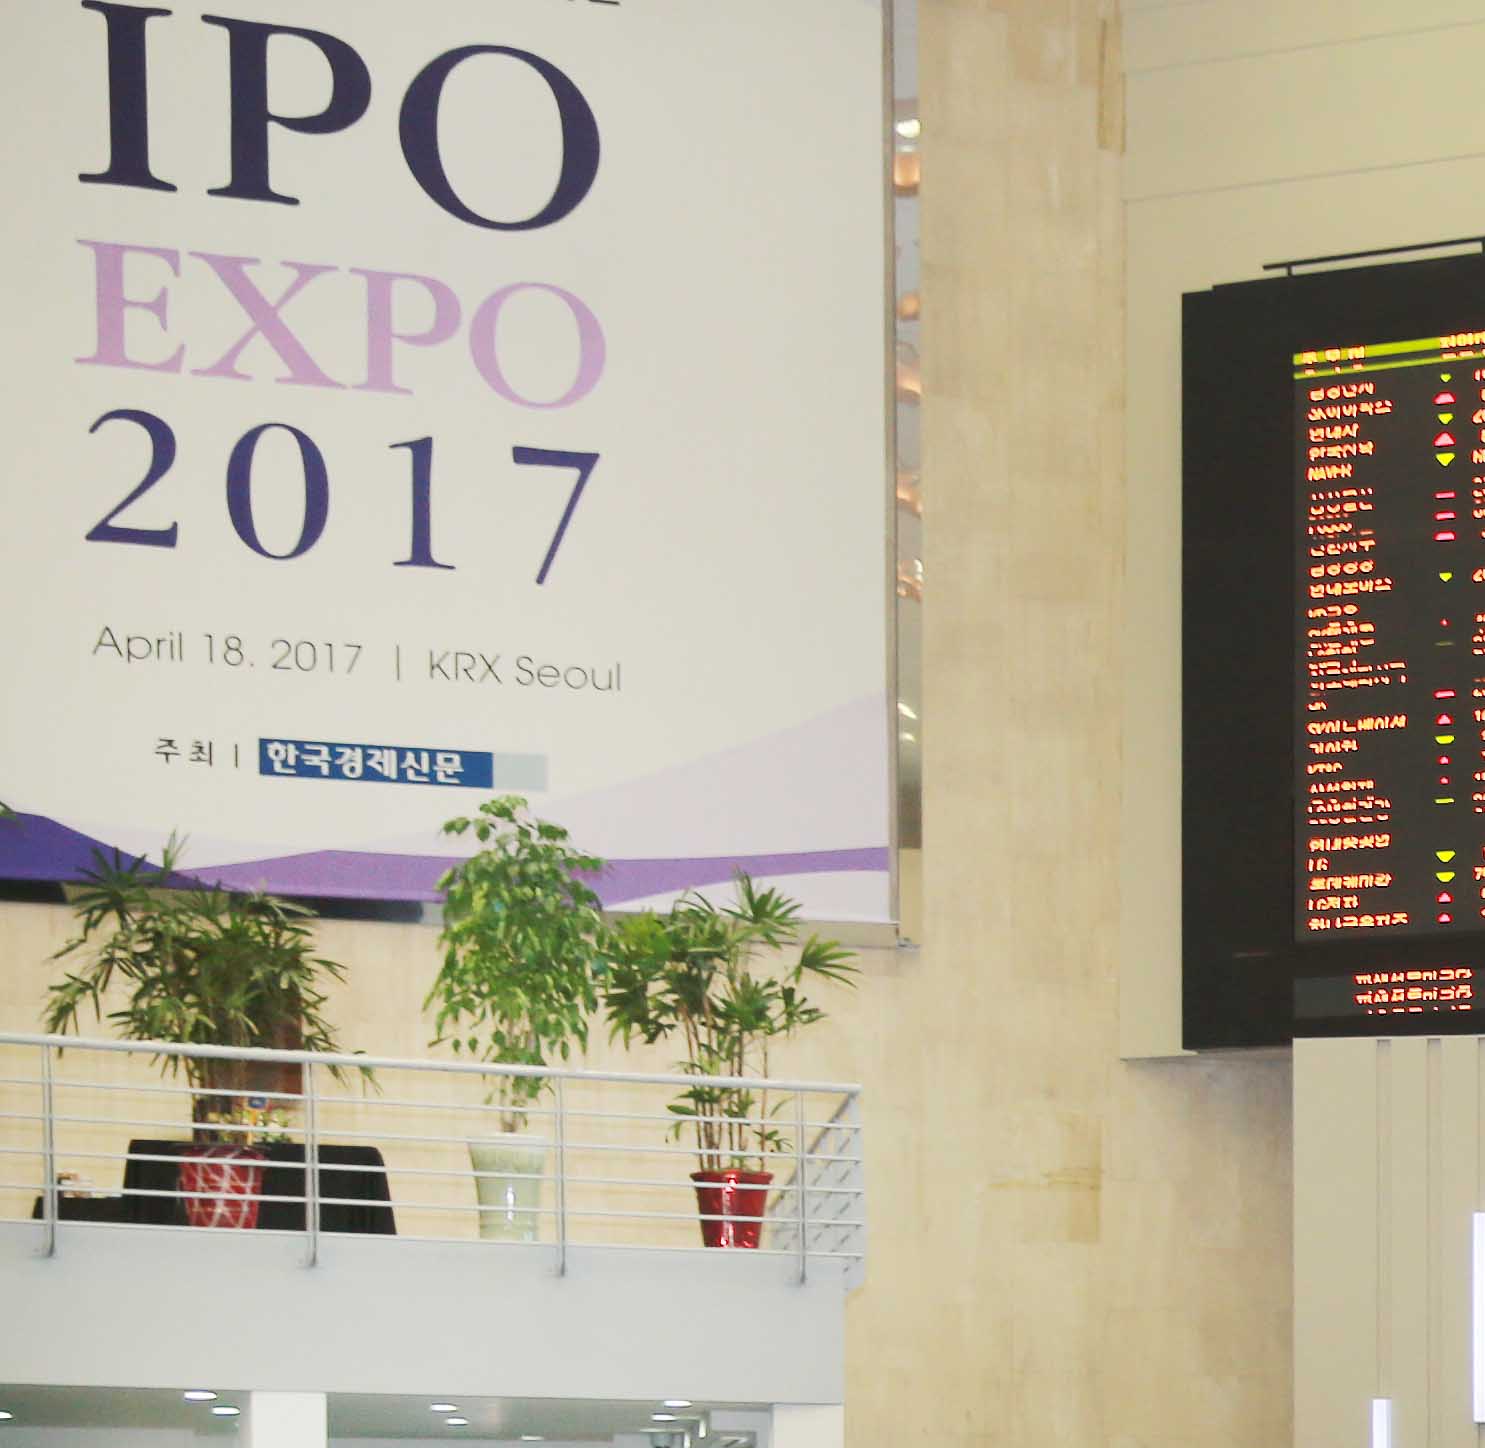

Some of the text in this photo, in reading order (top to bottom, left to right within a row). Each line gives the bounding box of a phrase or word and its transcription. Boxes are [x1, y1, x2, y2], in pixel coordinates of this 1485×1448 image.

[79, 0, 601, 232] IPO
[74, 239, 607, 409] EXPO
[84, 408, 600, 585] 2017
[92, 625, 623, 692] April 18. 2017 KRX Seoul
[265, 741, 465, 785] 한국경제신문
